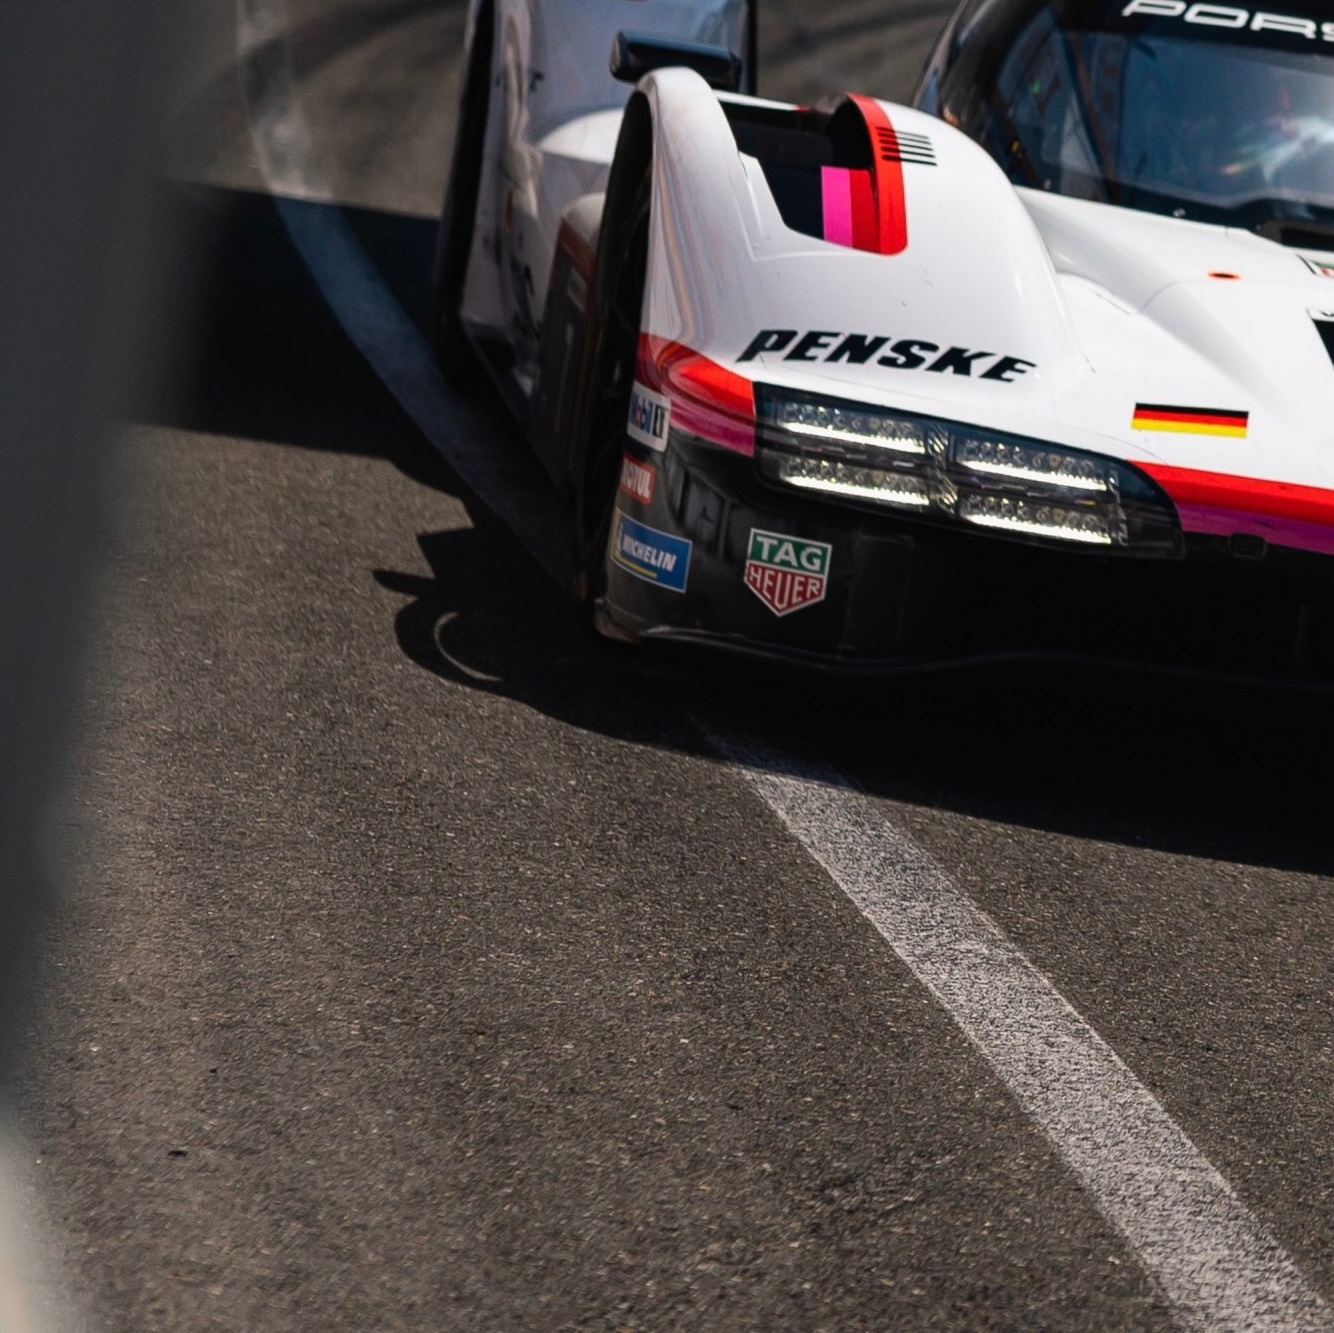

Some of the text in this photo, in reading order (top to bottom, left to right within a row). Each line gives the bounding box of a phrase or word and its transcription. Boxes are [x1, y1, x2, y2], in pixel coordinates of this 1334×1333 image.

[734, 329, 1038, 383] PENSKE
[622, 533, 677, 572] MICHELIN
[756, 535, 823, 572] TAG
[748, 566, 822, 609] HEUER
